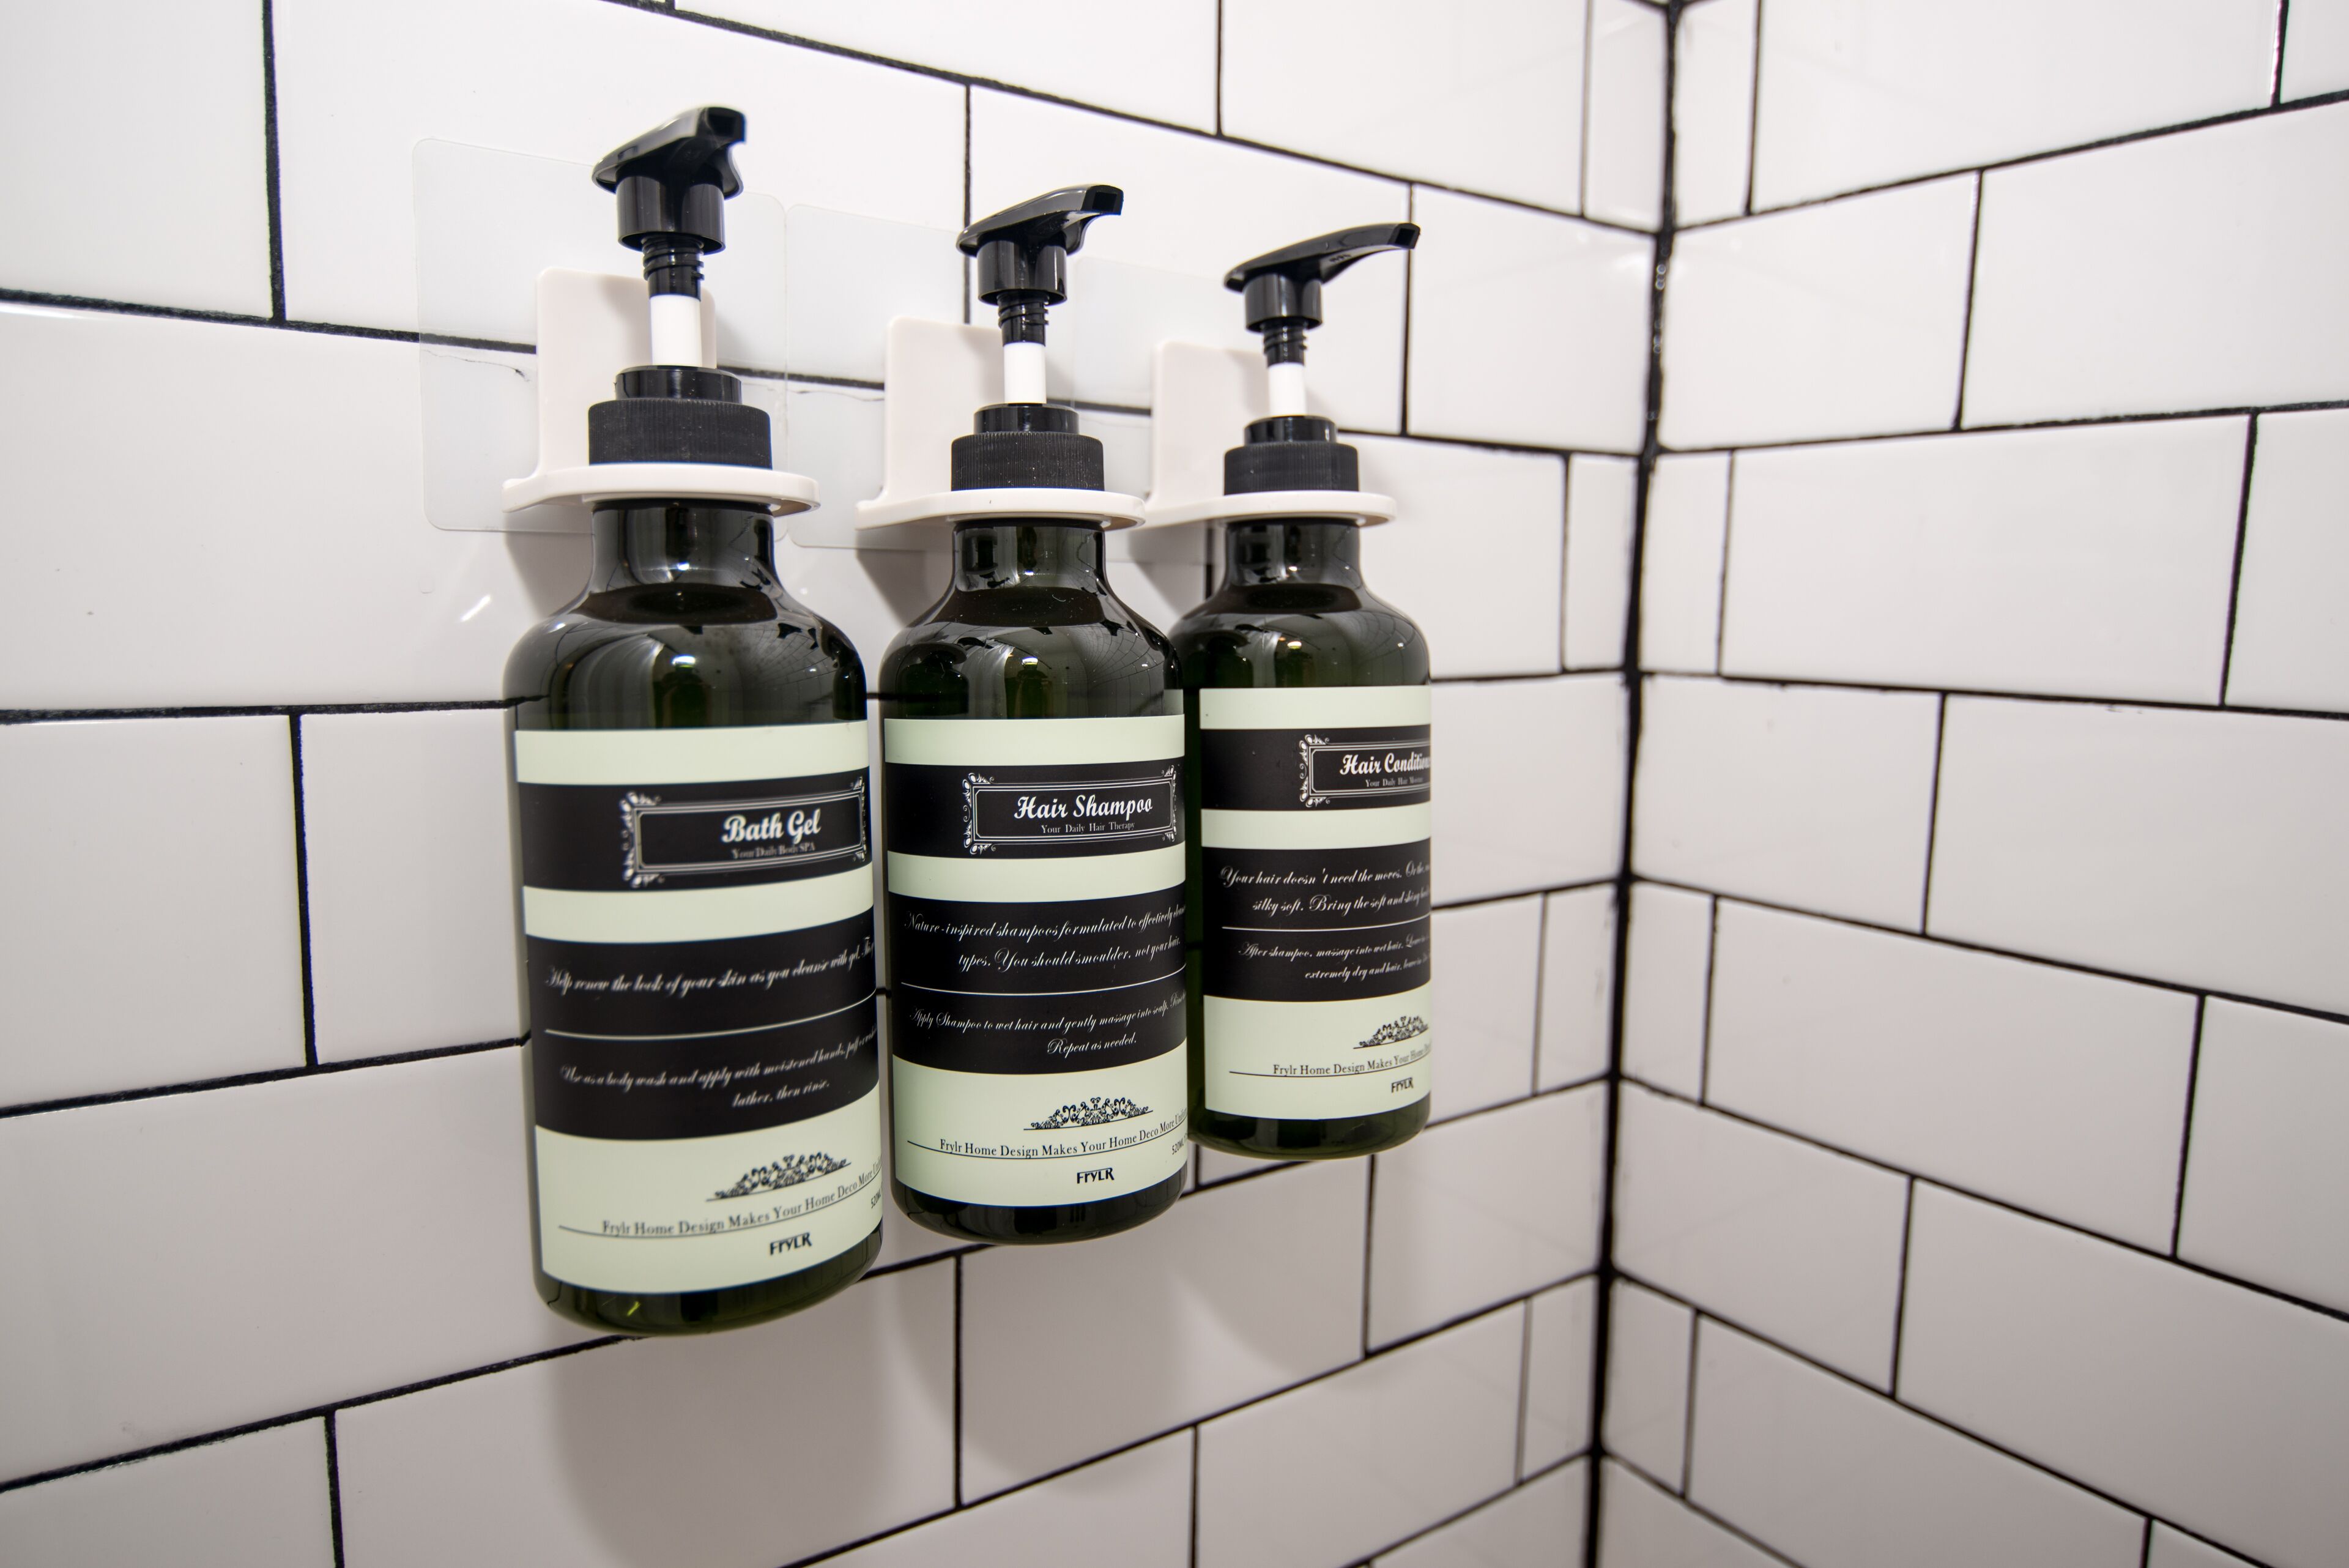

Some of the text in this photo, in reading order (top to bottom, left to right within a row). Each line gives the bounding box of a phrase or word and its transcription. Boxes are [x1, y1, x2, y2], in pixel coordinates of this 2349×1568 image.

[1340, 753, 1381, 775] Hair
[1365, 779, 1379, 787] Your
[1382, 778, 1396, 787] Daily
[1014, 795, 1152, 821] Hair Shampoo
[721, 808, 821, 844] Bath Gel
[1041, 822, 1135, 834] Your Daily Hair Therapy
[732, 842, 816, 859] Your Daily Body SPA
[1219, 866, 1255, 888] Your
[1255, 871, 1282, 884] hair
[1330, 869, 1358, 884] need
[1357, 869, 1373, 882] the
[1253, 897, 1278, 918] silky
[1280, 897, 1304, 916] soft.
[1309, 894, 1351, 917] Bring
[1354, 896, 1370, 909] the
[1370, 894, 1387, 913] soft
[1387, 891, 1405, 905] and
[904, 910, 996, 942] Nature-inspired
[996, 922, 1058, 943] shampoos
[1053, 915, 1127, 942] formulated
[1127, 918, 1136, 929] to
[1138, 907, 1172, 934] effectively
[959, 954, 991, 973] types.
[994, 948, 1029, 973] You
[1031, 950, 1075, 967] should
[1135, 945, 1150, 957] not
[1149, 942, 1168, 962] your
[1168, 935, 1181, 949] hair.
[1238, 942, 1267, 960] After
[1316, 948, 1354, 961] massage
[1374, 944, 1387, 953] wet
[546, 965, 573, 996] Help
[573, 980, 610, 990] renew
[611, 974, 633, 991] the
[633, 974, 662, 991] look
[665, 973, 684, 998] of
[680, 978, 716, 998] your
[717, 968, 746, 987] skin
[749, 970, 765, 984] as
[765, 968, 790, 990] you
[792, 959, 829, 976] cleanse
[830, 949, 847, 968] with
[1305, 967, 1350, 983] extremely
[1353, 966, 1368, 981] dry
[1369, 962, 1386, 975] and
[910, 1008, 933, 1030] Apply
[936, 1012, 981, 1033] Shampoo
[984, 1020, 993, 1030] to
[995, 1020, 1013, 1030] wet
[1014, 1018, 1039, 1030] hair
[1041, 1017, 1064, 1030] and
[1062, 1014, 1097, 1035] gently
[1099, 1011, 1137, 1027] massage
[1137, 1008, 1151, 1018] into
[1047, 1031, 1137, 1058] Repeat as needed.
[583, 1074, 595, 1084] as
[596, 1076, 604, 1084] a
[606, 1071, 634, 1093] body
[635, 1071, 667, 1086] wash
[668, 1069, 699, 1085] and
[698, 1066, 732, 1090] apply
[733, 1061, 760, 1079] with
[763, 1050, 818, 1075] moistened
[1273, 1065, 1297, 1076] Frylr
[1300, 1065, 1330, 1075] Home
[1334, 1063, 1365, 1074] Design
[1367, 1058, 1392, 1070] Makes
[1393, 1055, 1409, 1066] Your
[1410, 1047, 1423, 1061] Home
[776, 1085, 800, 1100] then
[940, 1139, 962, 1154] Frylr
[965, 1142, 996, 1156] Home
[1000, 1145, 1038, 1159] Design
[1042, 1144, 1078, 1156] Makes
[1081, 1141, 1107, 1153] Your
[1109, 1135, 1137, 1148] Home
[1139, 1129, 1159, 1141] Deco
[1160, 1120, 1174, 1134] More
[602, 1170, 872, 1236] Frylr Home Design Makes Your Home Deco More
